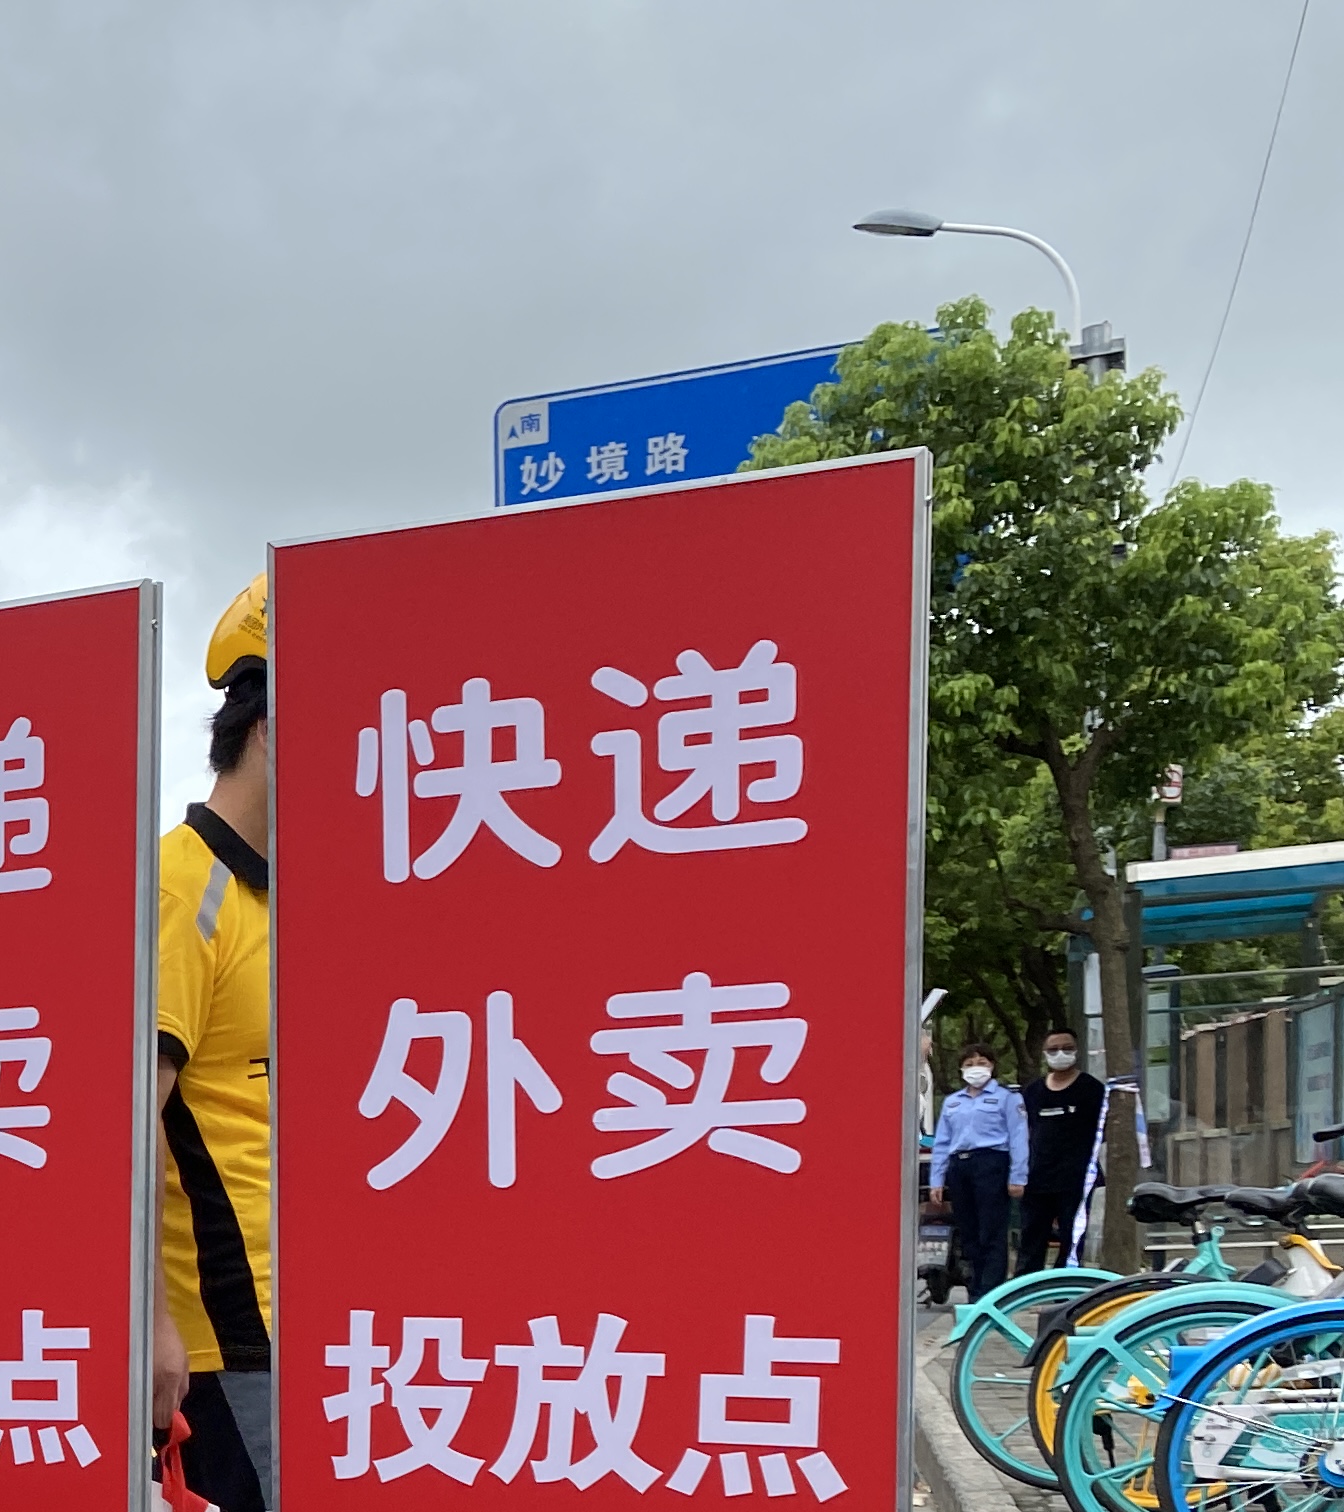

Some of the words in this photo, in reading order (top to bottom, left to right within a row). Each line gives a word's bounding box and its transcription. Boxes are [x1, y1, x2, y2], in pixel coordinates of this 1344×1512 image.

[519, 413, 542, 435] 南
[519, 432, 689, 495] 妙境路
[356, 640, 807, 883] 快递
[359, 972, 807, 1190] 外卖
[323, 1310, 848, 1502] 投放点
